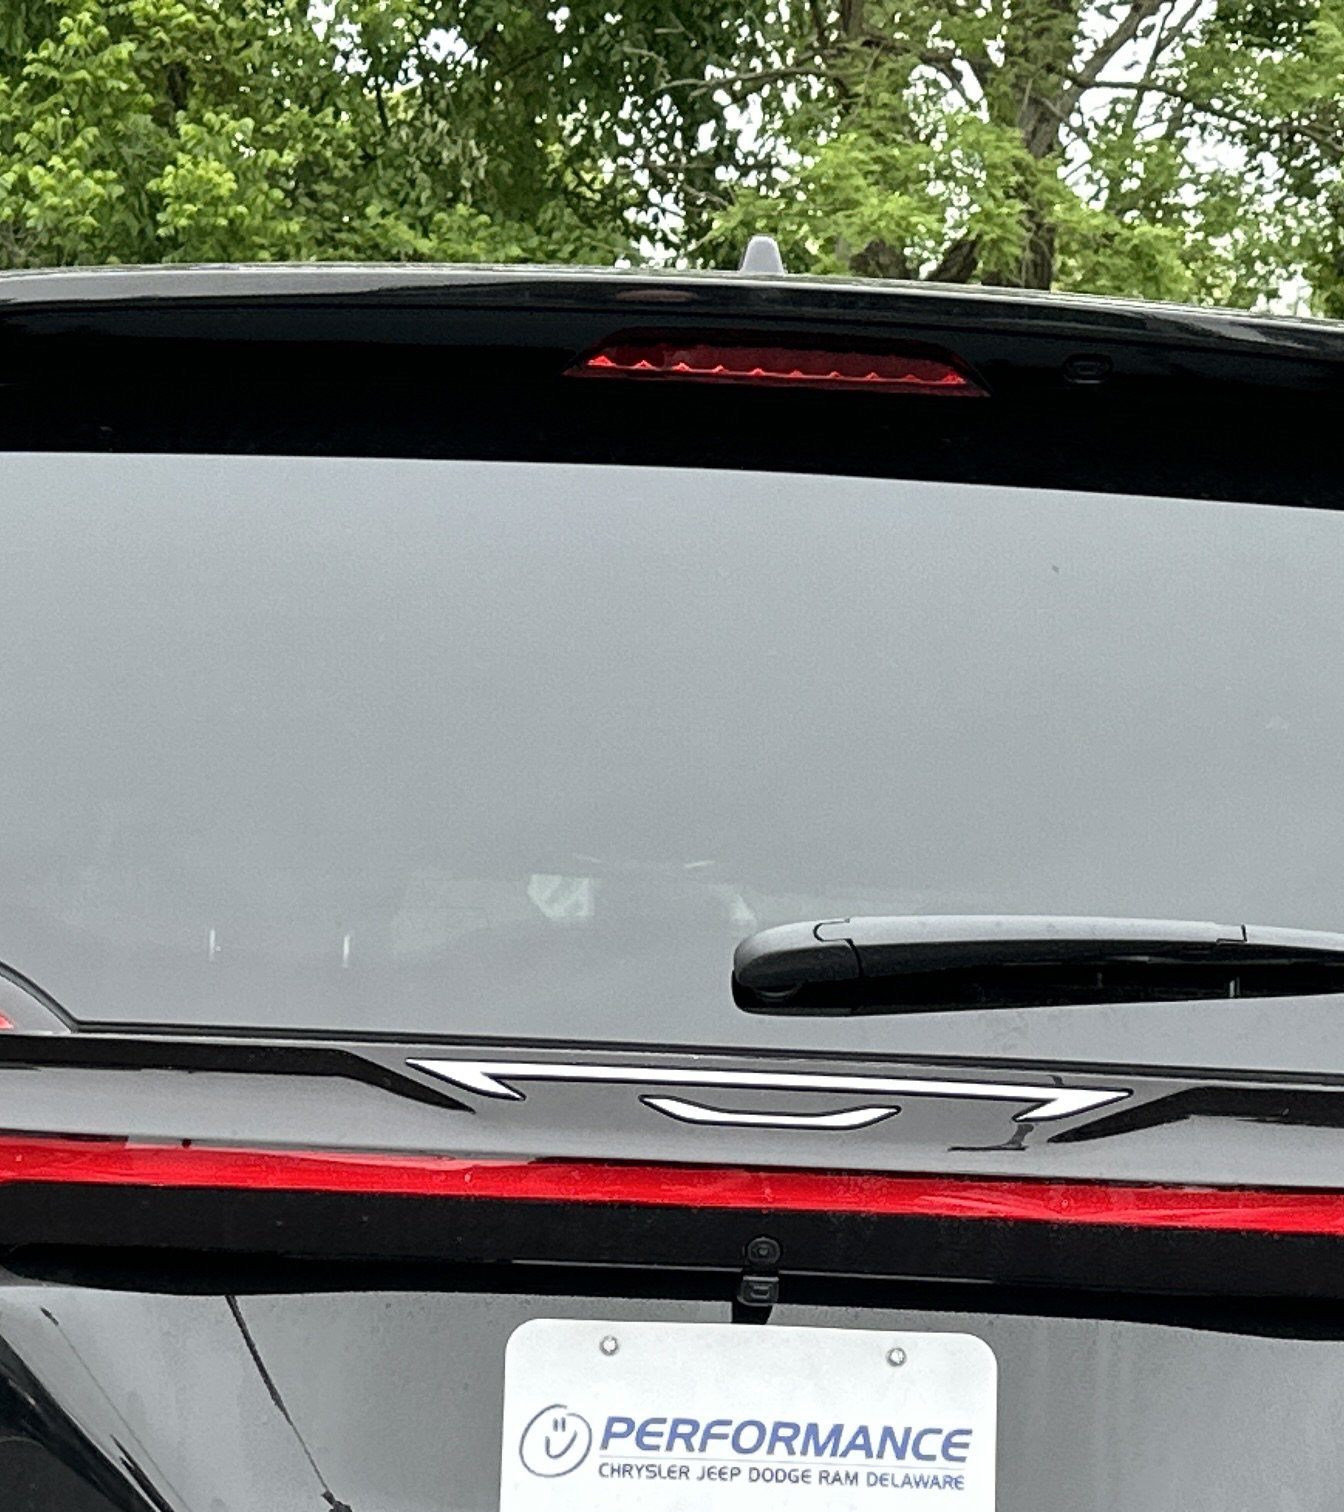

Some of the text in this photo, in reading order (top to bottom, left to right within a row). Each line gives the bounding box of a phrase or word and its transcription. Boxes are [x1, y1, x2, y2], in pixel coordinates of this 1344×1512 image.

[599, 1416, 974, 1463] PERFORMANCE
[598, 1462, 965, 1491] CHRYSLER JEEP DODGE RAM DELAWARE
